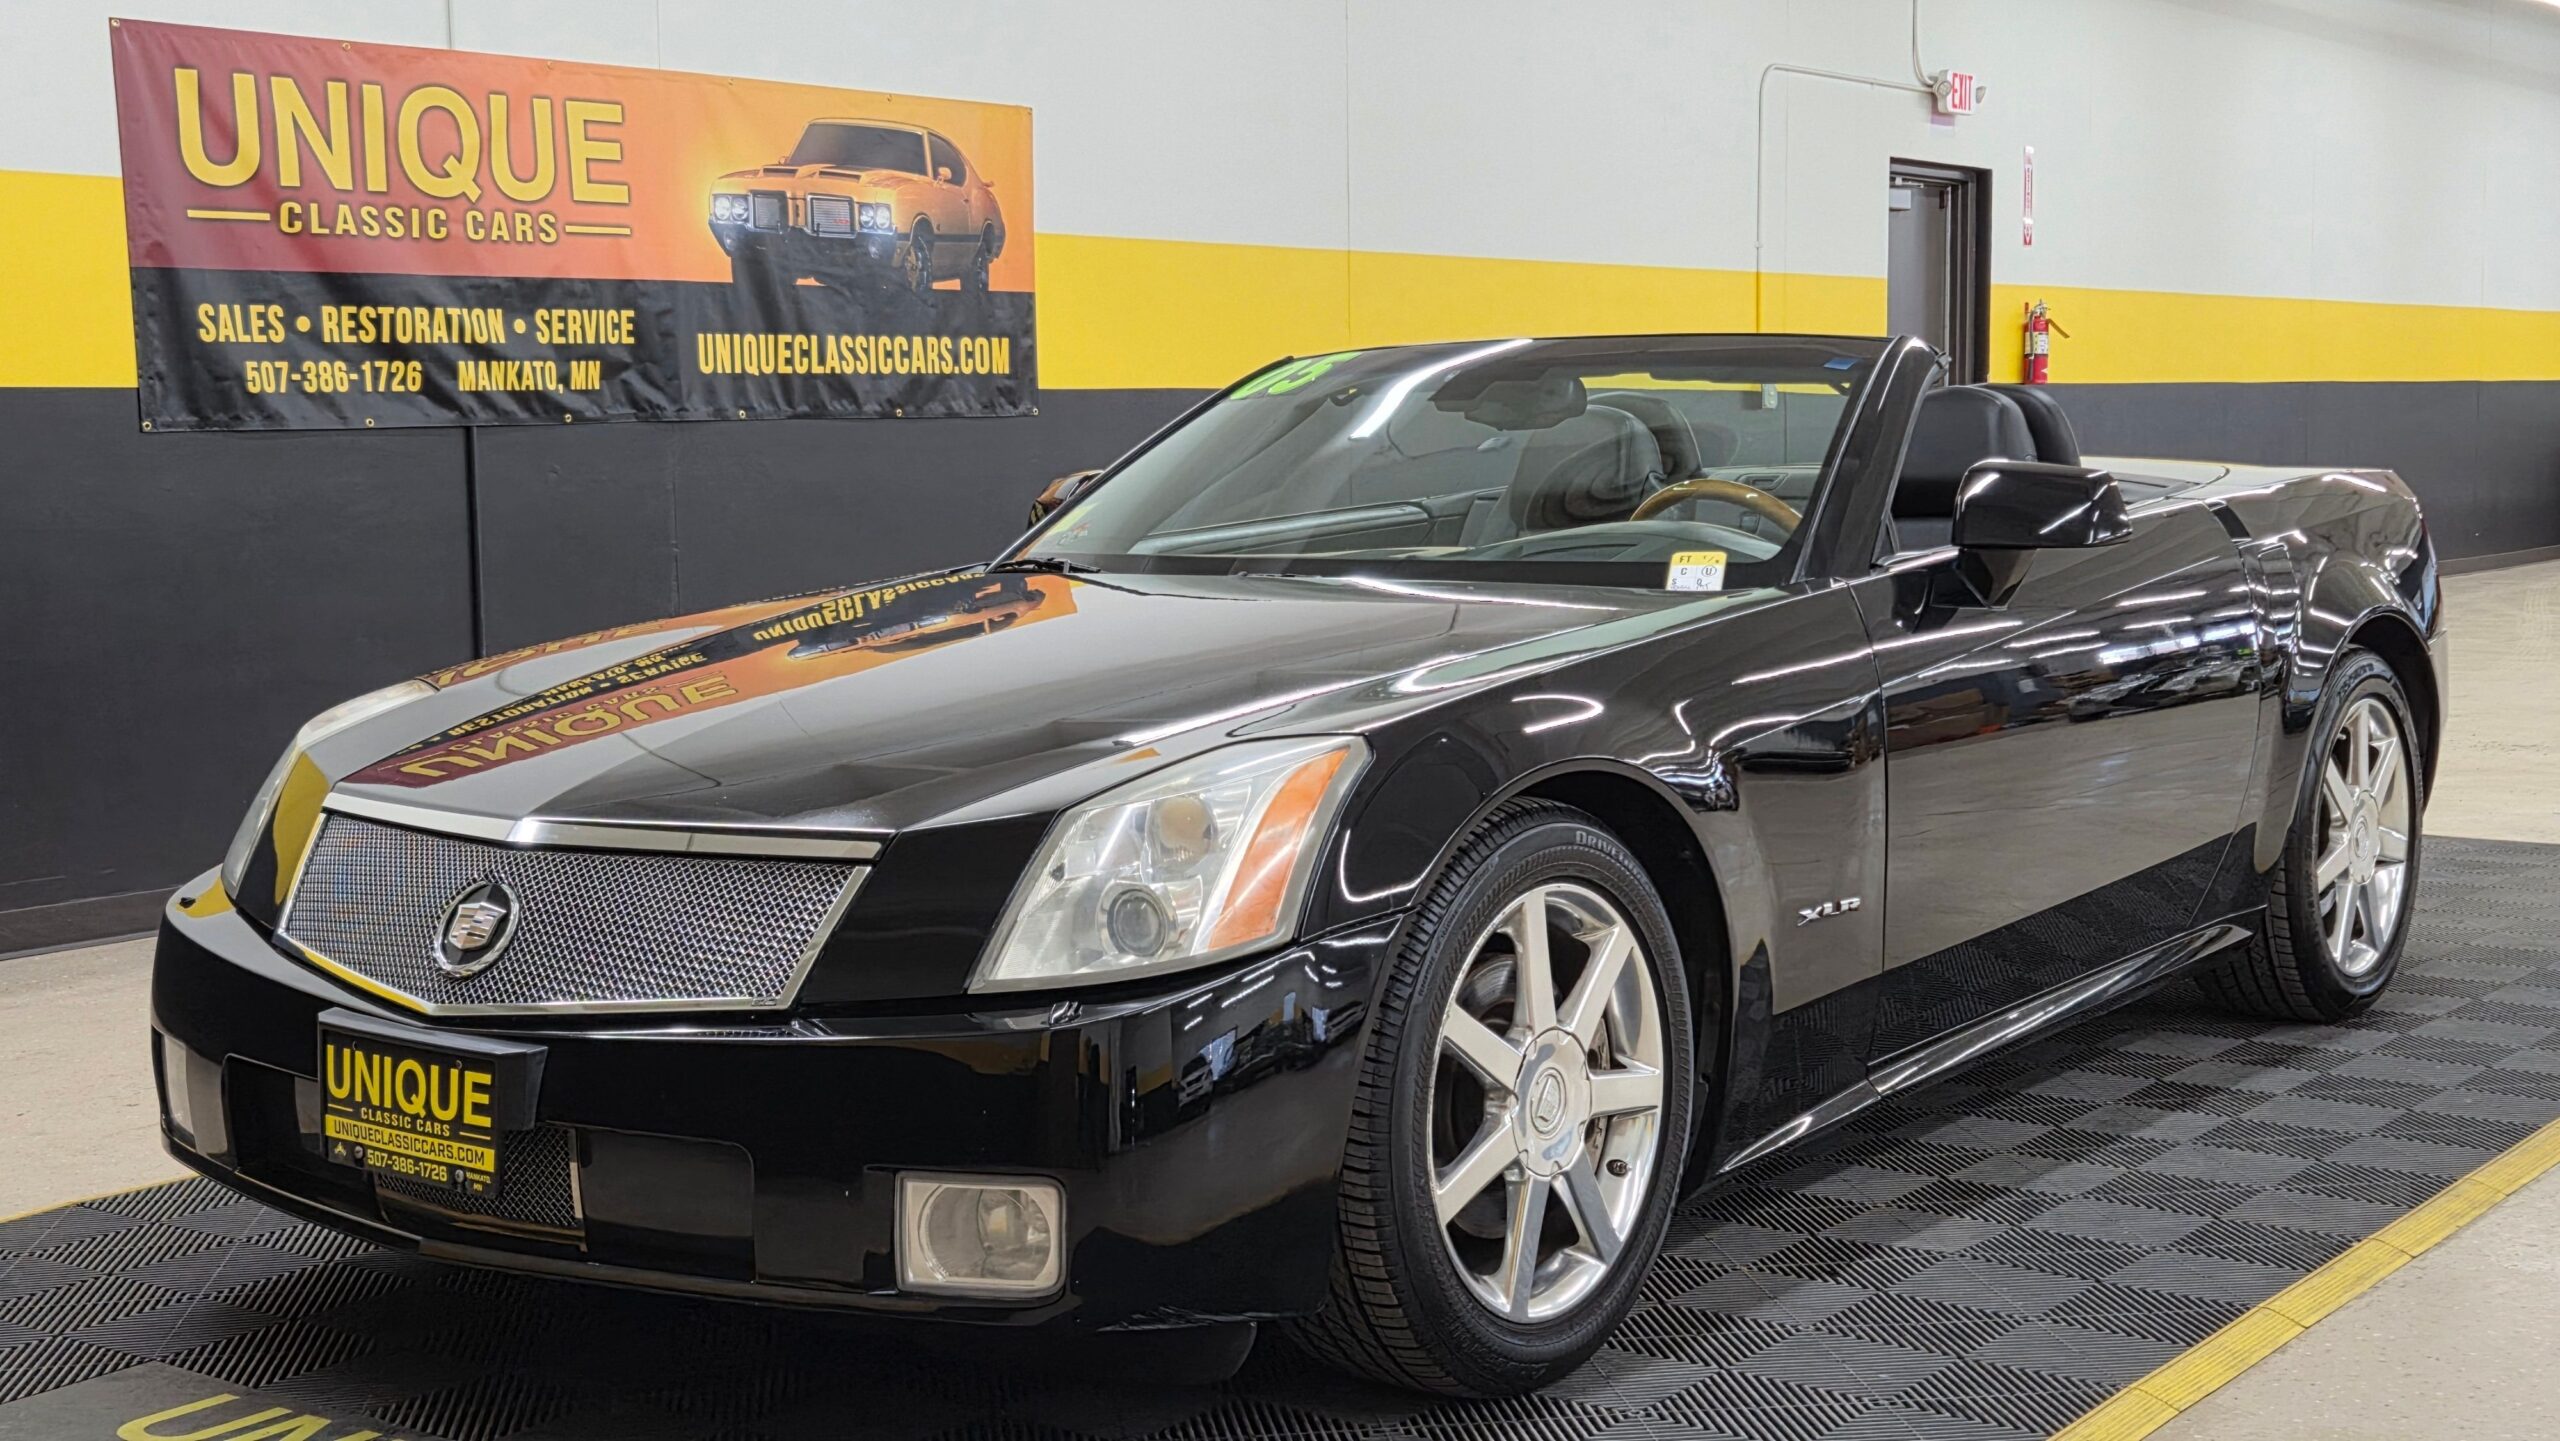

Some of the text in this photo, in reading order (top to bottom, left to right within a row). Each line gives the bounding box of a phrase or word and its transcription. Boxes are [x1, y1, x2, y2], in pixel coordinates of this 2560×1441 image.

[1952, 72, 1973, 111] EXIT
[174, 68, 630, 203] UNIQUE
[280, 202, 559, 243] CLASSIC CARS
[198, 304, 635, 345] SALES RESTORATION SERVICE
[697, 333, 1010, 376] UNIQUECLASSICCARS.COM
[246, 359, 601, 393] 507-386-1726 MANKATO, MN
[1797, 897, 1861, 927] XLR
[326, 1044, 492, 1128] UNIQUE
[334, 1119, 485, 1166] UNIQUECLASSICCARS.COM
[361, 1107, 451, 1137] CLASSIC CARS
[367, 1149, 448, 1182] 507-386-1726
